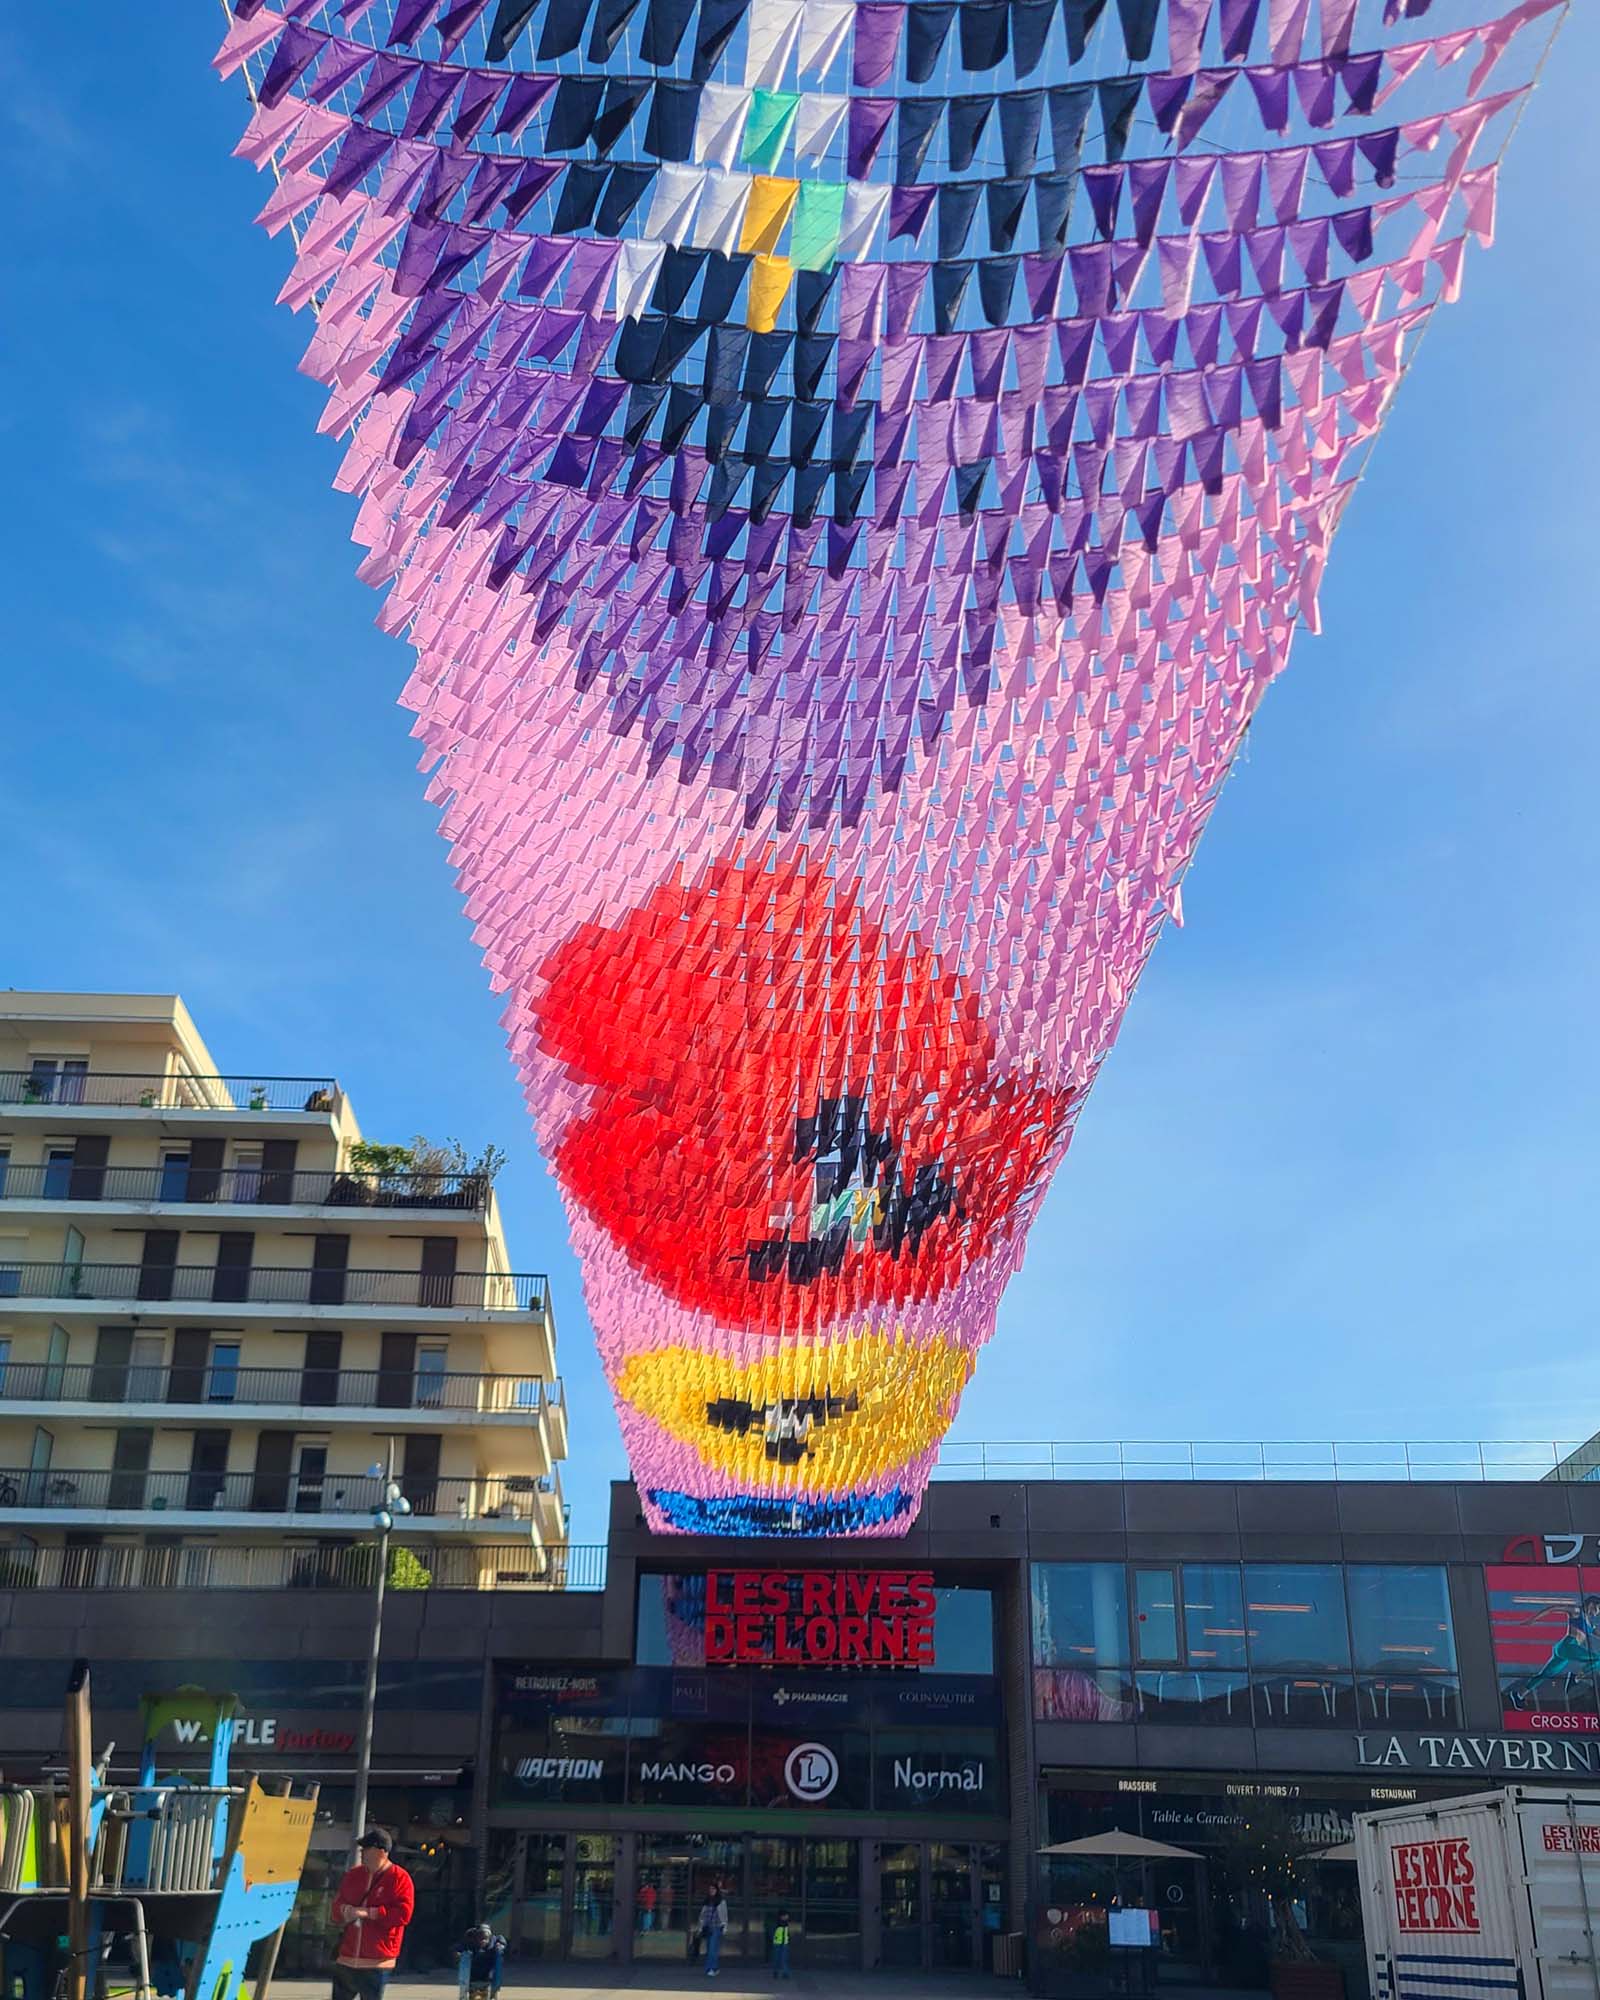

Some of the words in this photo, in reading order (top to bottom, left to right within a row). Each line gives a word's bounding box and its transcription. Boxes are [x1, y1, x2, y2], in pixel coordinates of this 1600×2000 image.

[705, 1574, 792, 1615] LES
[802, 1575, 937, 1618] RIVES
[705, 1618, 764, 1657] DE
[775, 1616, 936, 1660] L'ORNE
[674, 1687, 705, 1698] PAUL
[790, 1690, 849, 1703] PHARMACIE
[1531, 1714, 1579, 1729] CROSS
[174, 1719, 277, 1745] WFLE
[1354, 1735, 1412, 1767] LA
[1418, 1737, 1600, 1772] TAVERN
[526, 1758, 604, 1779] ACTION
[640, 1762, 736, 1783] MANGO
[893, 1757, 984, 1791] Normal
[1118, 1780, 1158, 1793] BRASSERIE
[1226, 1784, 1255, 1796] OUVERT
[1370, 1788, 1417, 1800] RESTAURANT
[1151, 1809, 1182, 1824] Table
[1542, 1825, 1566, 1839] LES
[1544, 1838, 1563, 1850] DE
[1391, 1847, 1422, 1888] LES
[1423, 1842, 1475, 1887] RIVES
[1395, 1887, 1418, 1929] DE
